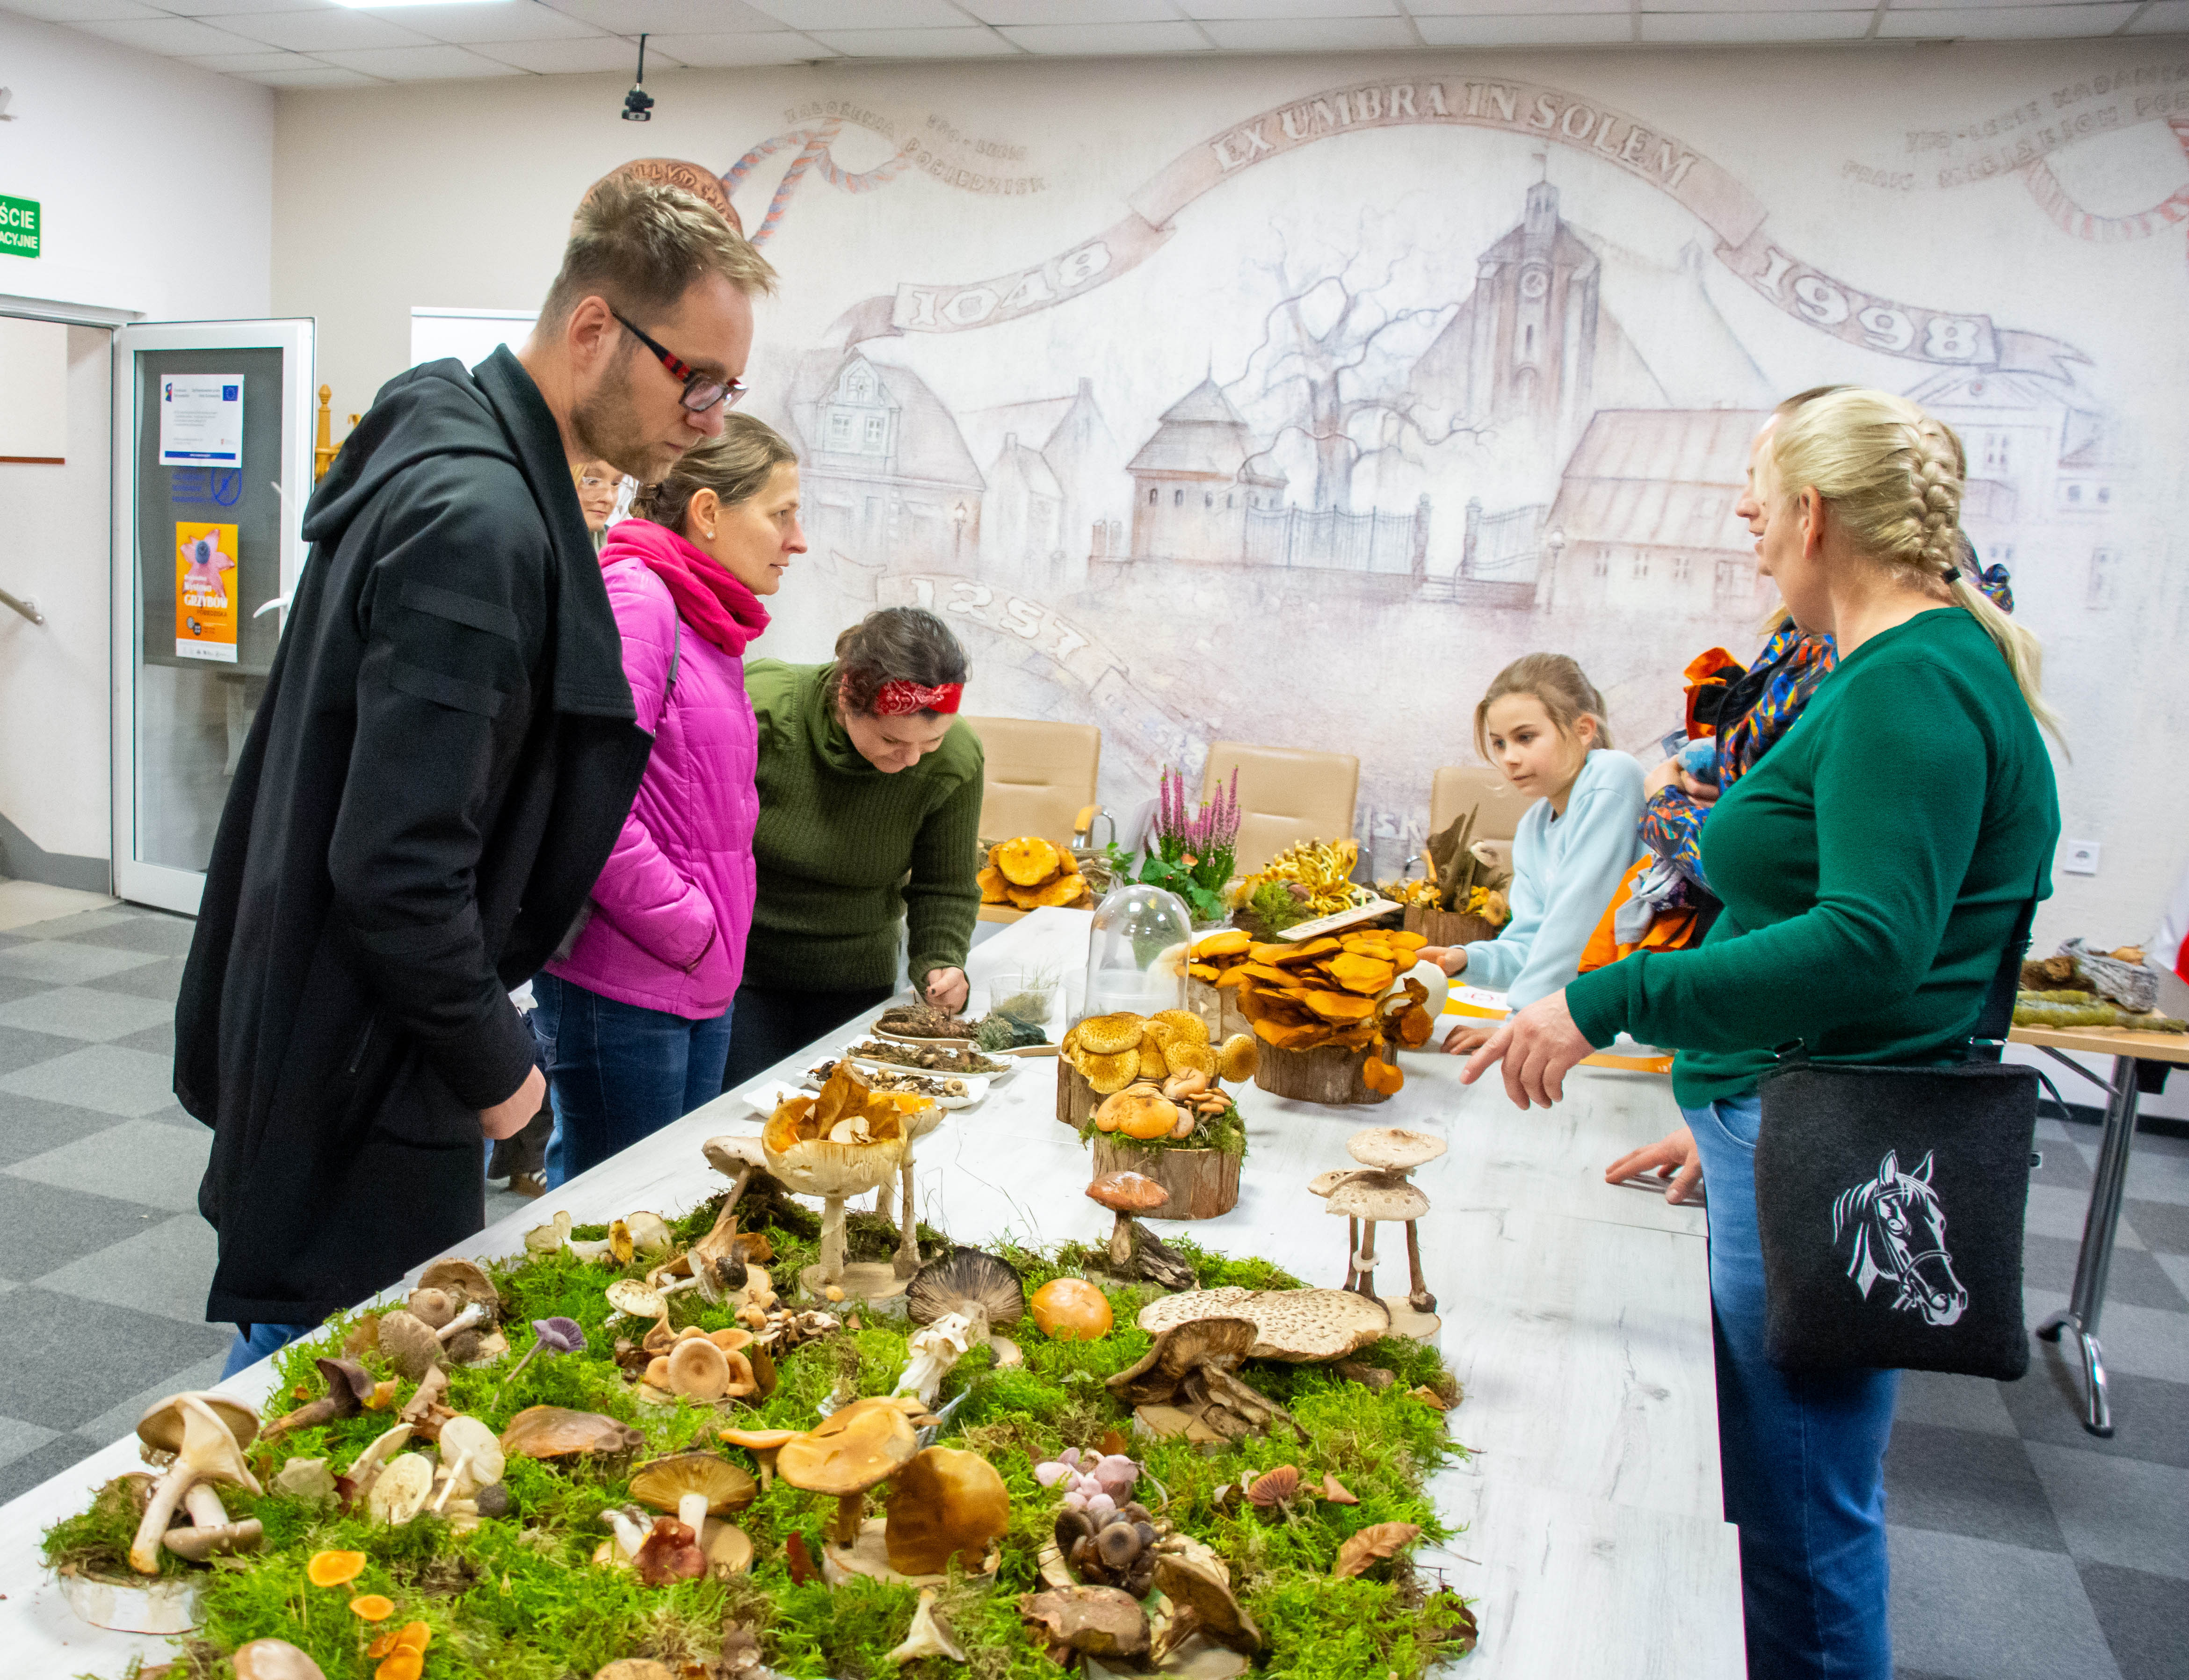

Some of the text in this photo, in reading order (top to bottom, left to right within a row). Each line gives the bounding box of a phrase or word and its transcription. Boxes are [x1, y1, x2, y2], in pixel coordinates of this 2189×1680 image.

[1210, 80, 1700, 191] EX UMBRA IN SOLEM
[0, 202, 35, 229] ŚCIE
[0, 231, 38, 249] ACYJNE
[909, 240, 1112, 326] 1048
[1753, 246, 1980, 360] 1998
[910, 577, 1090, 660] 1257
